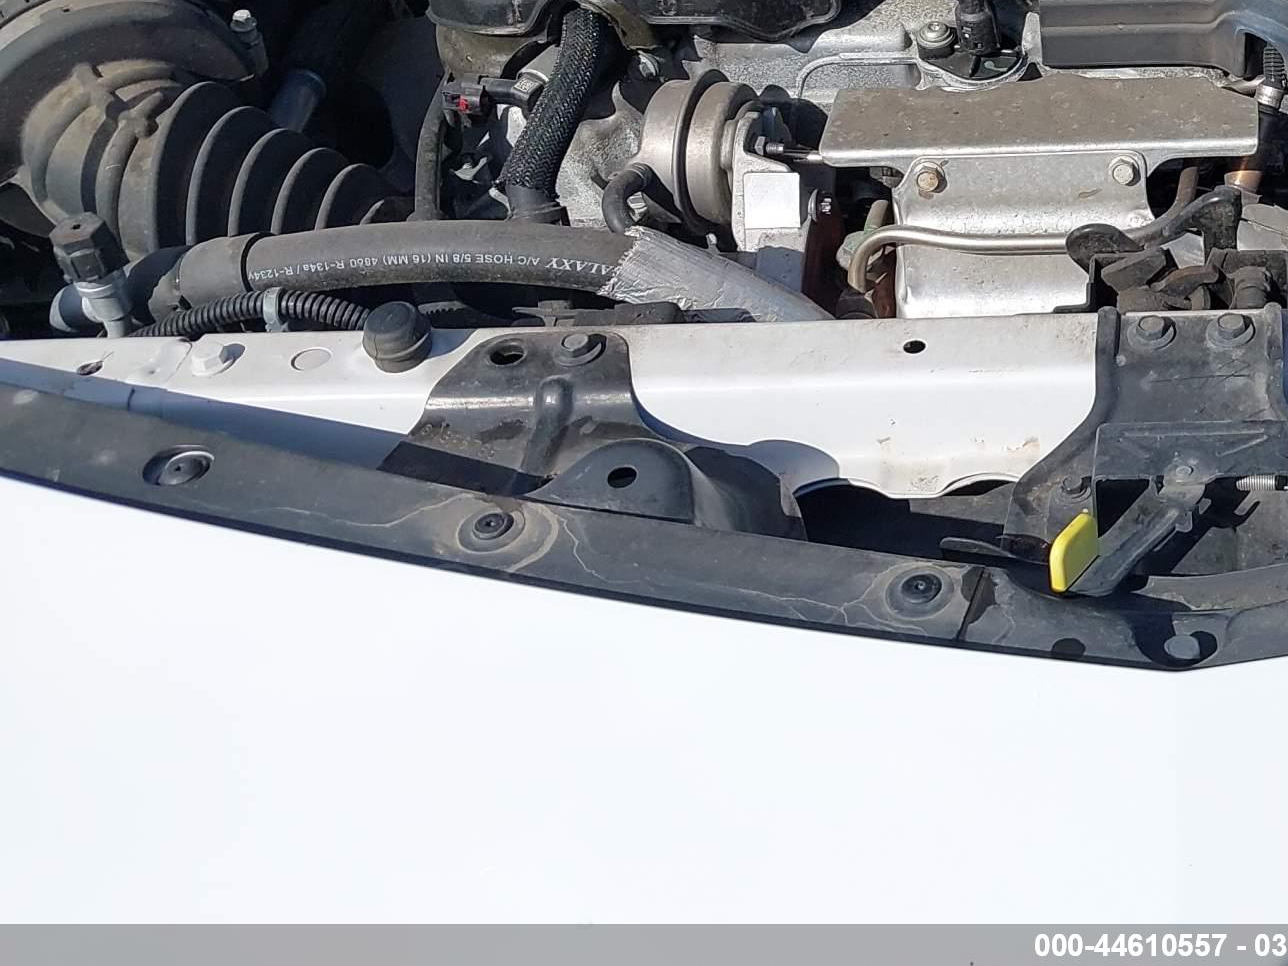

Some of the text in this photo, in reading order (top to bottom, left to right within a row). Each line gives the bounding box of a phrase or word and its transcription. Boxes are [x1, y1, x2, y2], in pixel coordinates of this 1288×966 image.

[383, 255, 409, 266] MM)
[412, 254, 432, 265] (16
[436, 254, 449, 264] IN
[453, 253, 471, 264] 5/8
[475, 253, 513, 265] HOSE
[517, 256, 540, 266] A/C
[303, 260, 345, 273] R-134a
